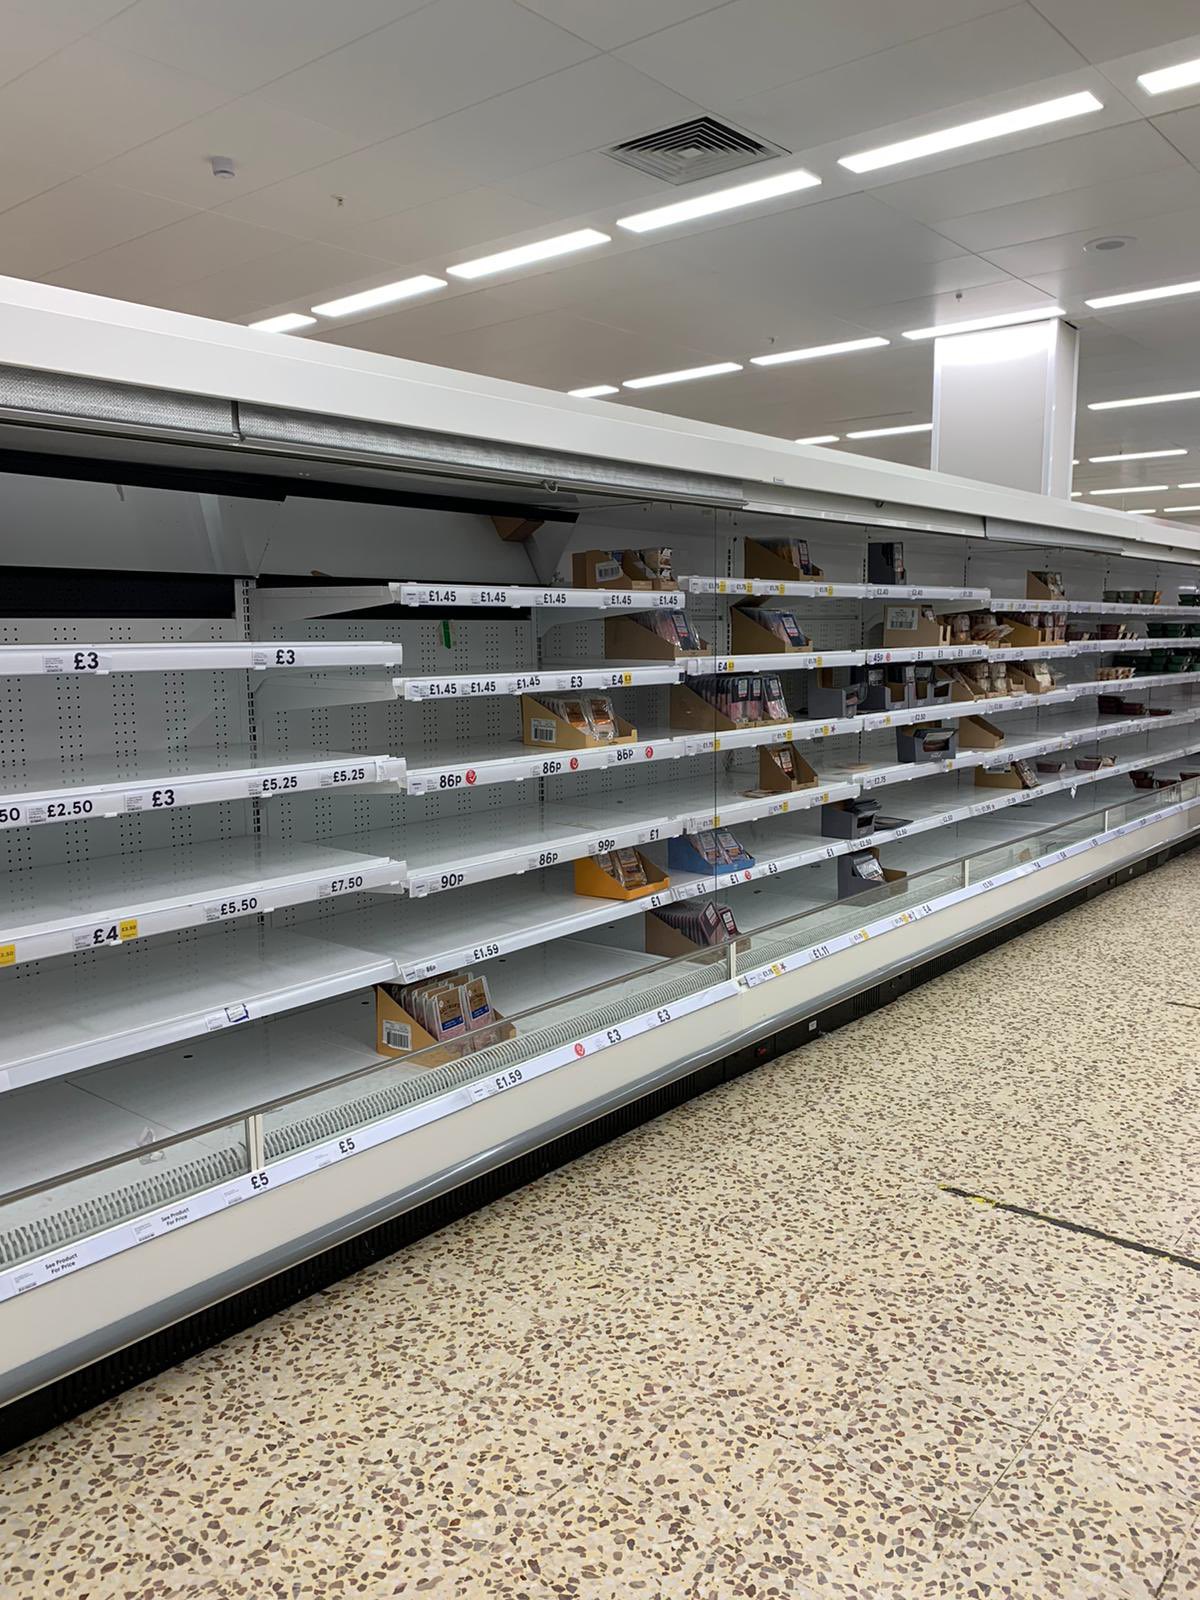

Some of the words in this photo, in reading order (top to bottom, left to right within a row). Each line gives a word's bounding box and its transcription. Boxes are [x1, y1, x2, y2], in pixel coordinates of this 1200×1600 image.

[428, 590, 456, 602] £1.45
[480, 591, 506, 602] £1.45
[544, 593, 566, 604] £1.45
[612, 595, 632, 605] £1.45
[660, 596, 678, 605] £1.45
[74, 652, 99, 670] £3
[276, 650, 295, 665] £3
[718, 662, 727, 671] £4
[517, 676, 541, 690] £1.45
[571, 676, 582, 688] £3
[612, 674, 623, 686] £4
[430, 683, 457, 696] £1.45
[470, 681, 496, 693] £1.45
[332, 768, 365, 783] £5.25
[262, 776, 298, 791] £5.25
[152, 790, 175, 807] £3
[47, 800, 93, 818] £2.50
[650, 829, 659, 840] £1
[826, 848, 834, 858] £1
[768, 863, 778, 873] £3
[331, 876, 363, 892] £7.50
[730, 874, 739, 884] £1
[697, 883, 706, 894] £1
[220, 898, 258, 916] £5.50
[651, 896, 660, 906] £1
[924, 904, 932, 914] £4
[93, 926, 119, 945] £4
[474, 944, 499, 960] £1.59
[813, 946, 830, 959] £1.11
[657, 1009, 671, 1023] £3
[607, 1029, 622, 1044] £3
[496, 1069, 523, 1090] £1.59
[339, 1138, 355, 1154] £5
[251, 1172, 269, 1189] £5
[170, 1208, 190, 1219] Product
[176, 1214, 188, 1224] Price
[46, 1262, 56, 1270] See
[56, 1253, 78, 1266] Product
[62, 1261, 76, 1272] Price
